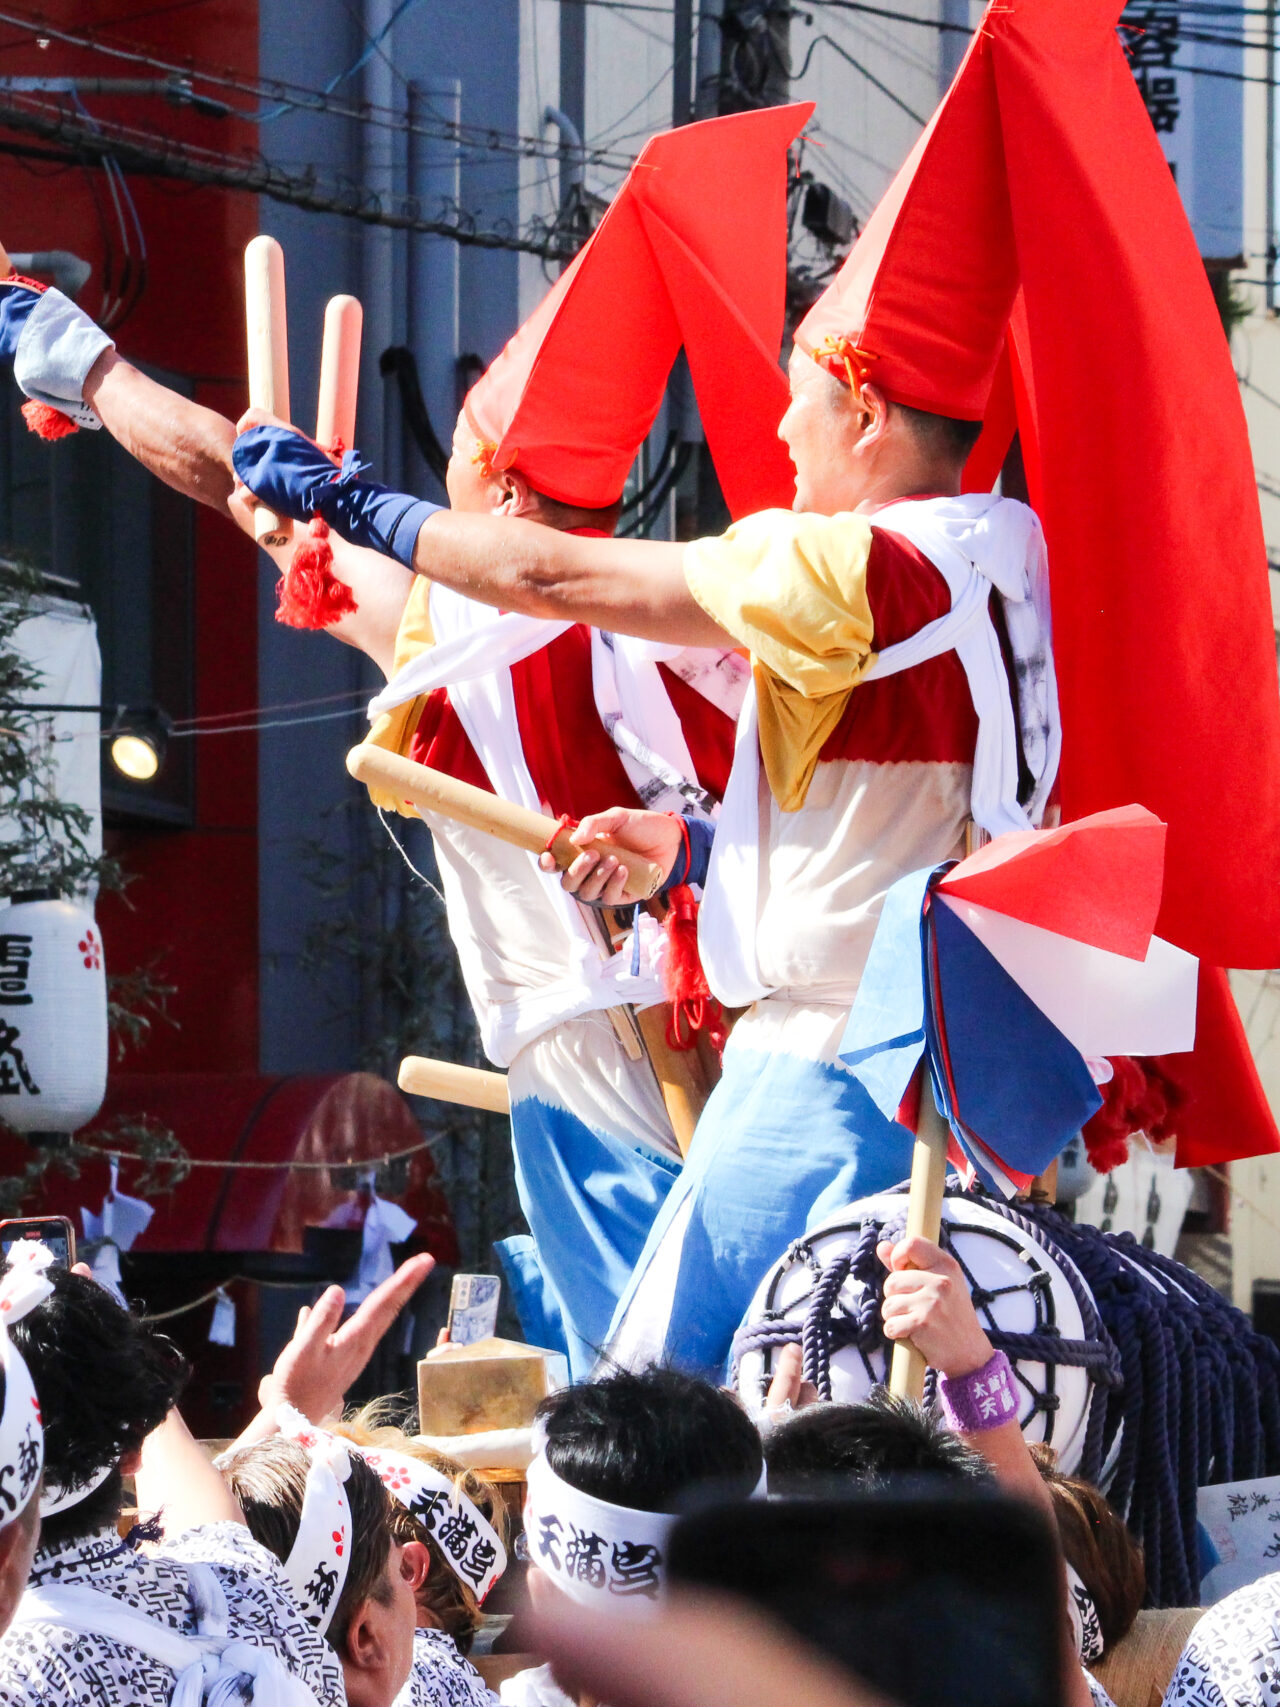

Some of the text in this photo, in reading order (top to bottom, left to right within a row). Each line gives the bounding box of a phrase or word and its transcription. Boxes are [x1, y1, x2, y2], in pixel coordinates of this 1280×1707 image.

[410, 1487, 497, 1588] 天満宮
[538, 1514, 663, 1601] 天満宮
